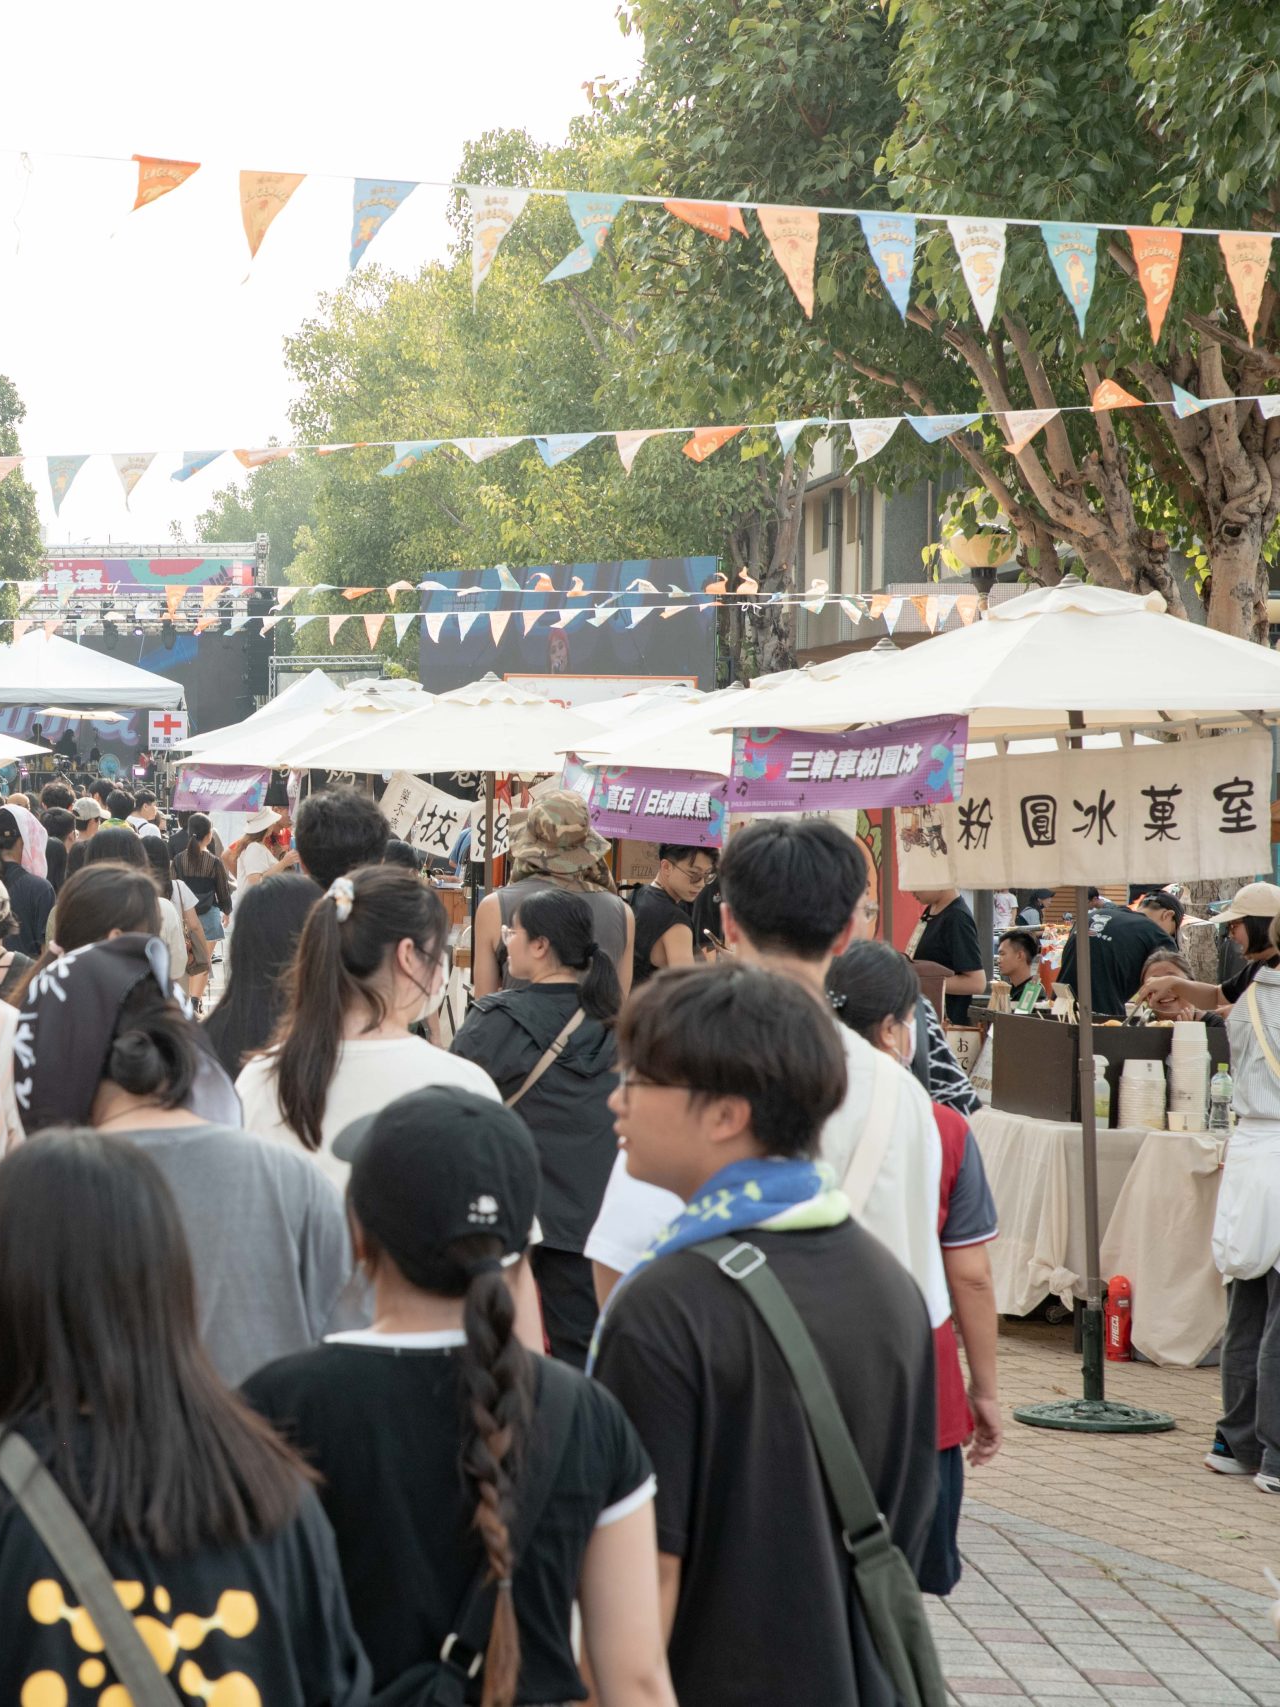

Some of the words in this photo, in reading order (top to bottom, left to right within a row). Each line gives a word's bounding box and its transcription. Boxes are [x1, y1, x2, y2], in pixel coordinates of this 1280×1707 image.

[785, 743, 923, 781] 三輪車粉圓冰
[957, 776, 1257, 850] 粉圓冰菓室
[631, 865, 653, 877] PIZZA
